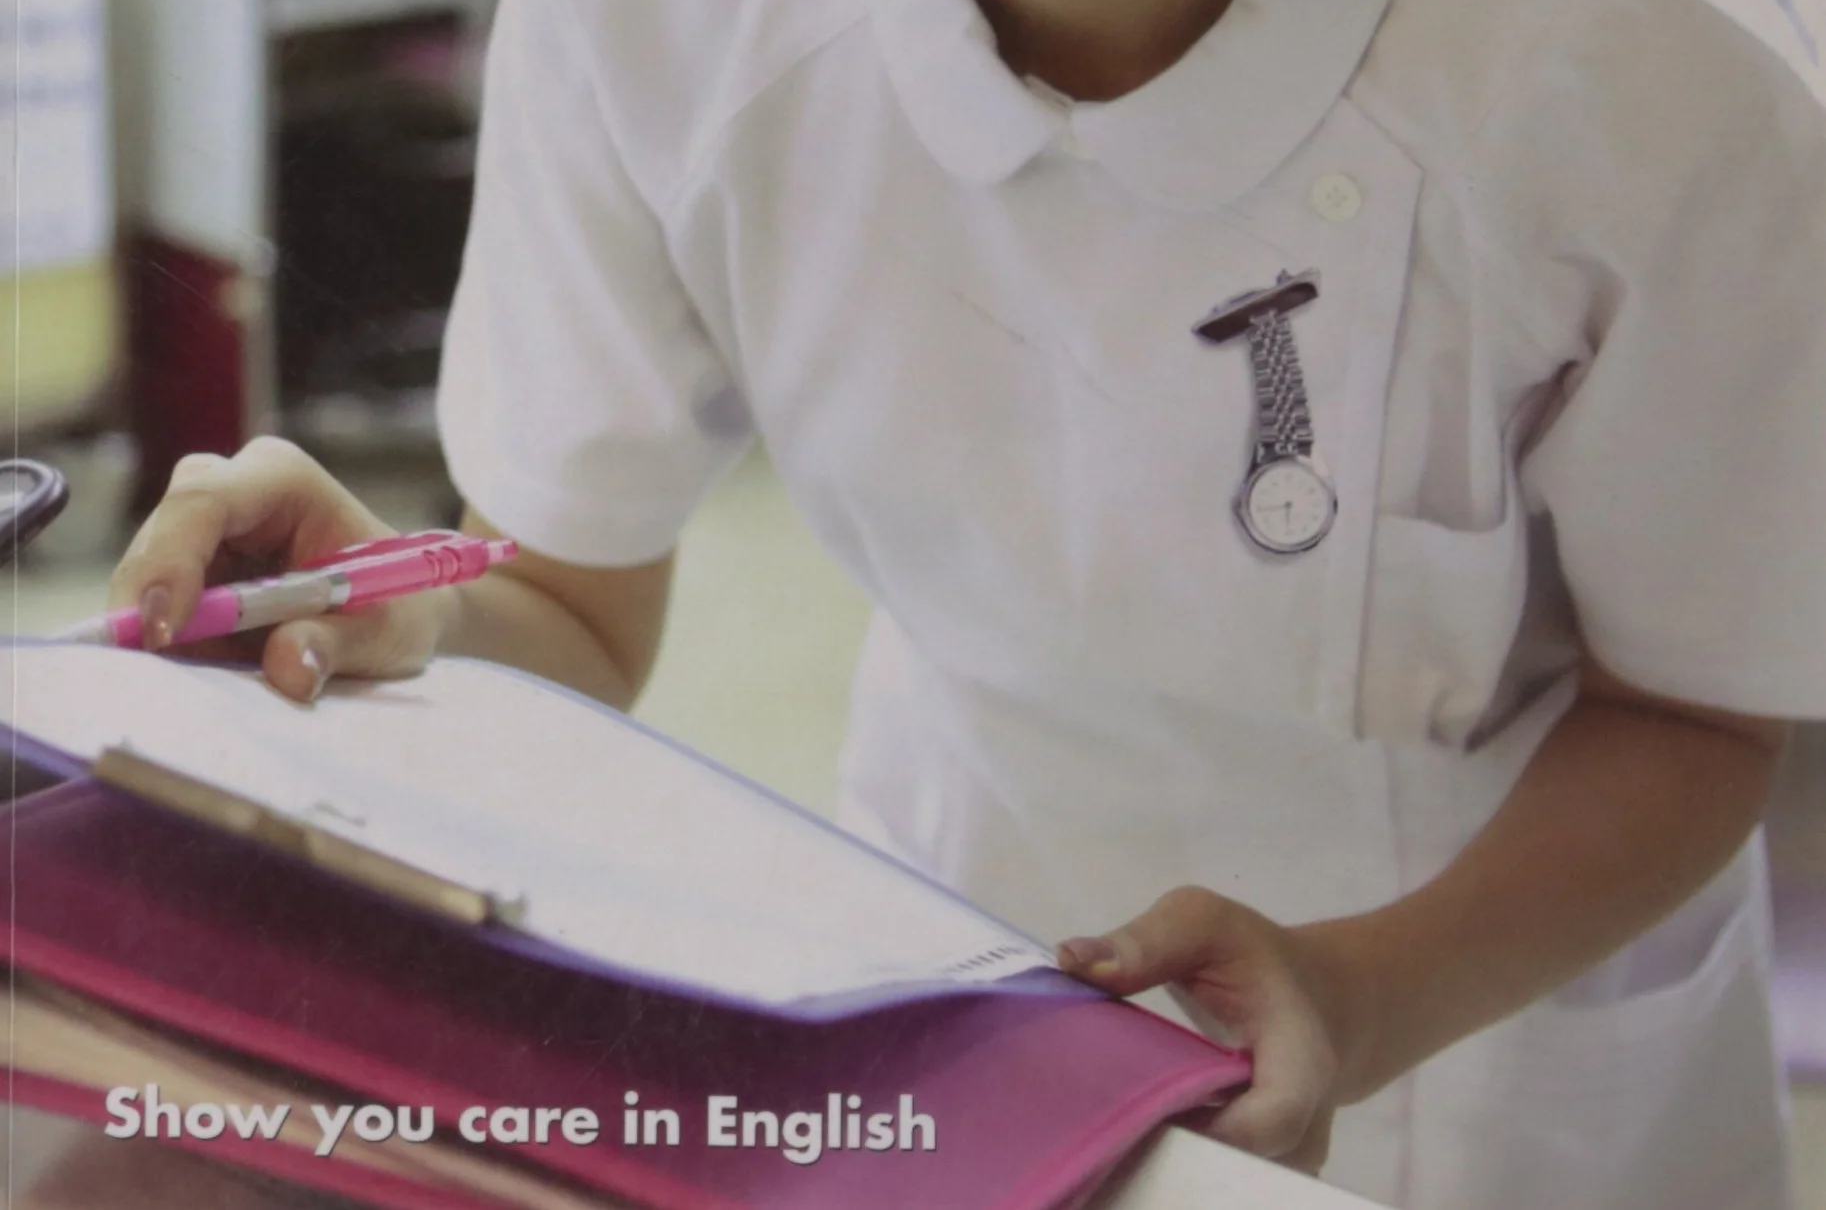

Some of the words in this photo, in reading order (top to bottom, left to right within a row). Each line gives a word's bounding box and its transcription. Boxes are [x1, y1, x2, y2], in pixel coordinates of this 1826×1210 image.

[104, 1081, 290, 1140] Show
[311, 1105, 435, 1156] you
[459, 1105, 600, 1145] care
[624, 1091, 681, 1146] in
[706, 1092, 937, 1165] English
